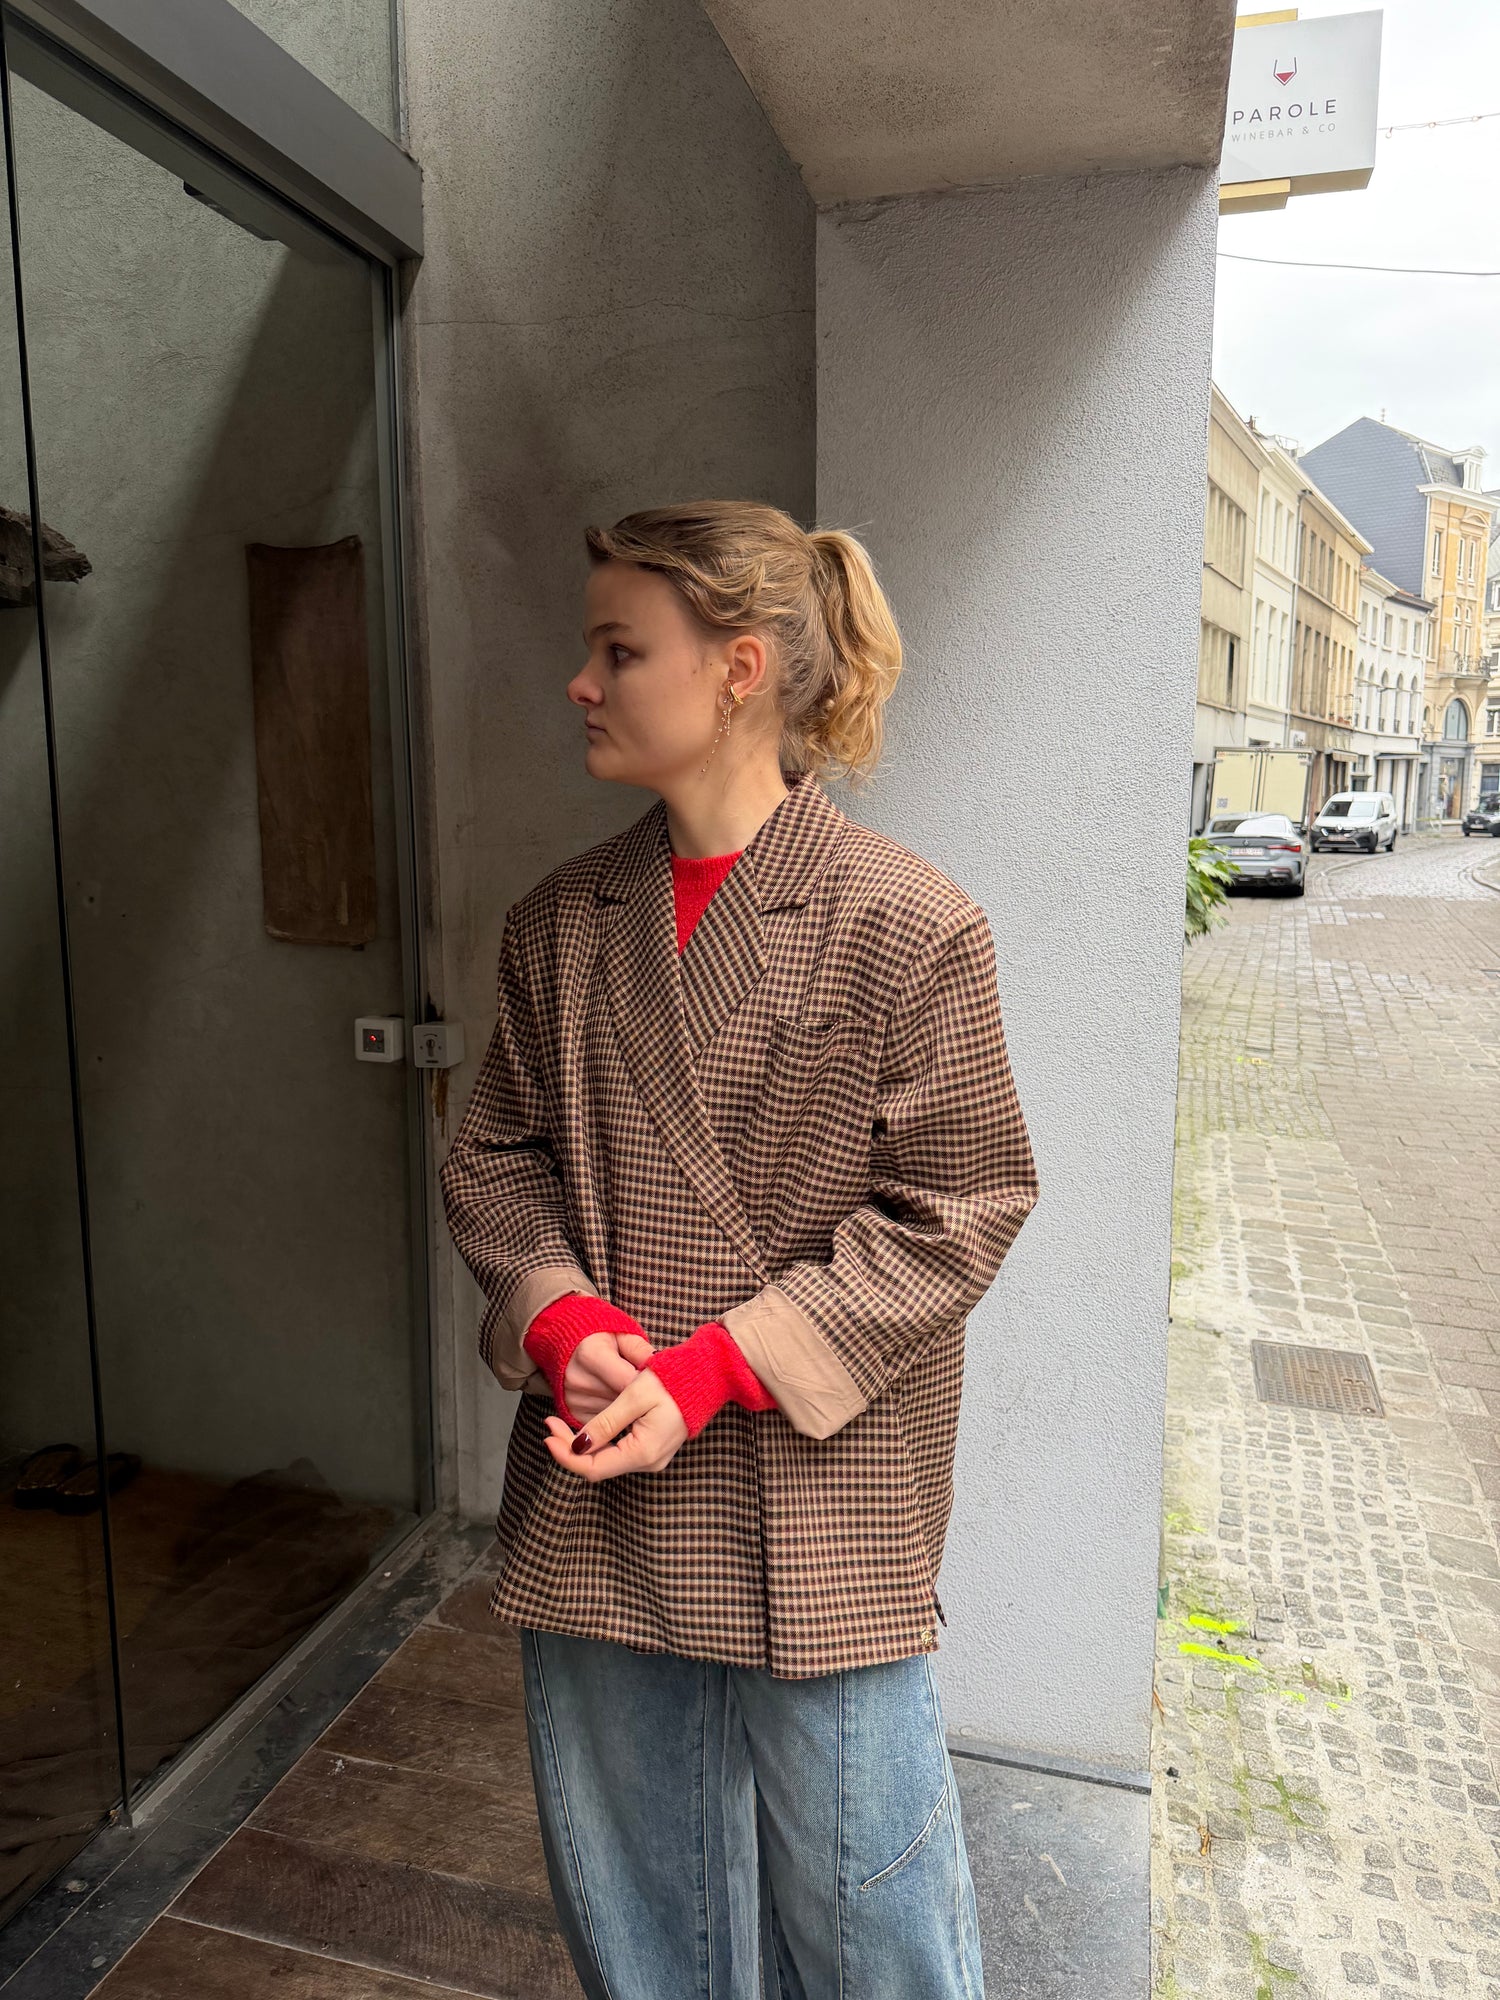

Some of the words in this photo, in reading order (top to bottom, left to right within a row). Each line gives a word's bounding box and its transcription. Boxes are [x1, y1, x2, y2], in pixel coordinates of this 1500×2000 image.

[1232, 99, 1337, 125] PAROLE
[1231, 127, 1293, 142] WINEBAR
[1302, 126, 1309, 135] &
[1318, 122, 1336, 133] CO
